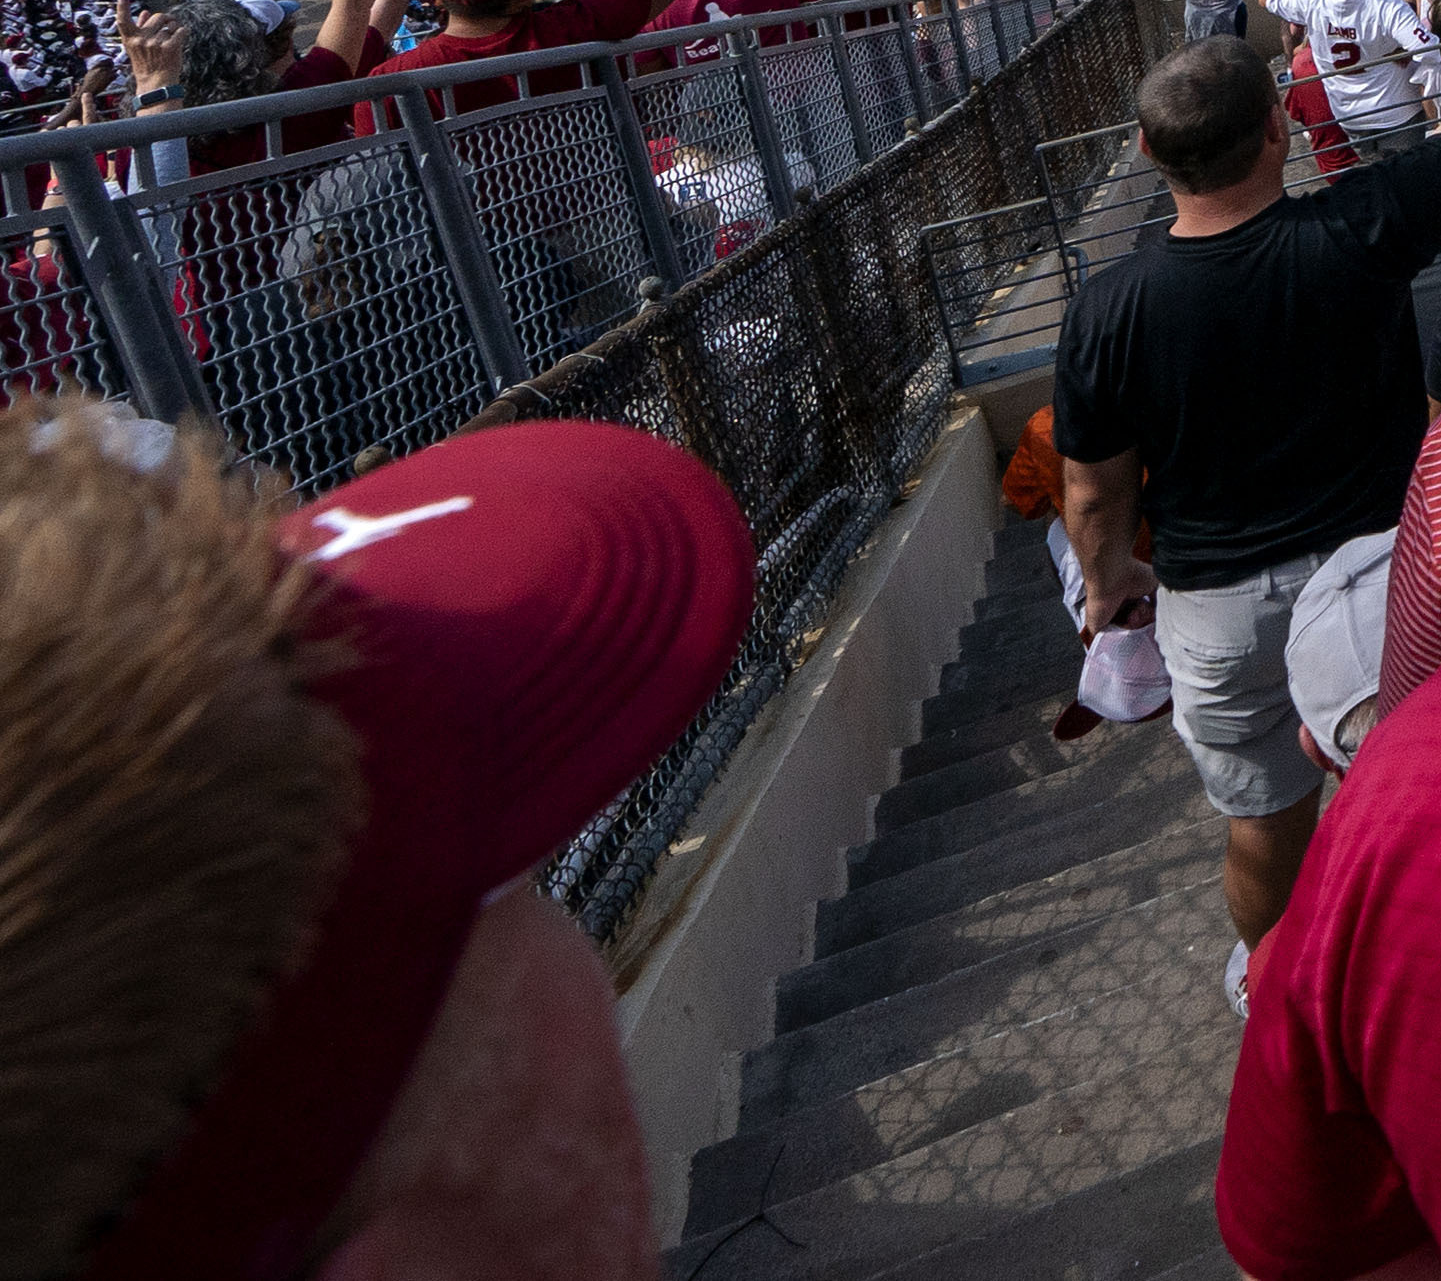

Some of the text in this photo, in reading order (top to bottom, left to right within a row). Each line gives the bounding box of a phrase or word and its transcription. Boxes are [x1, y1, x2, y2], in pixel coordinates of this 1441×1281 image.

[1327, 21, 1359, 40] LAMB
[1413, 27, 1431, 44] 2
[1331, 41, 1361, 72] 2
